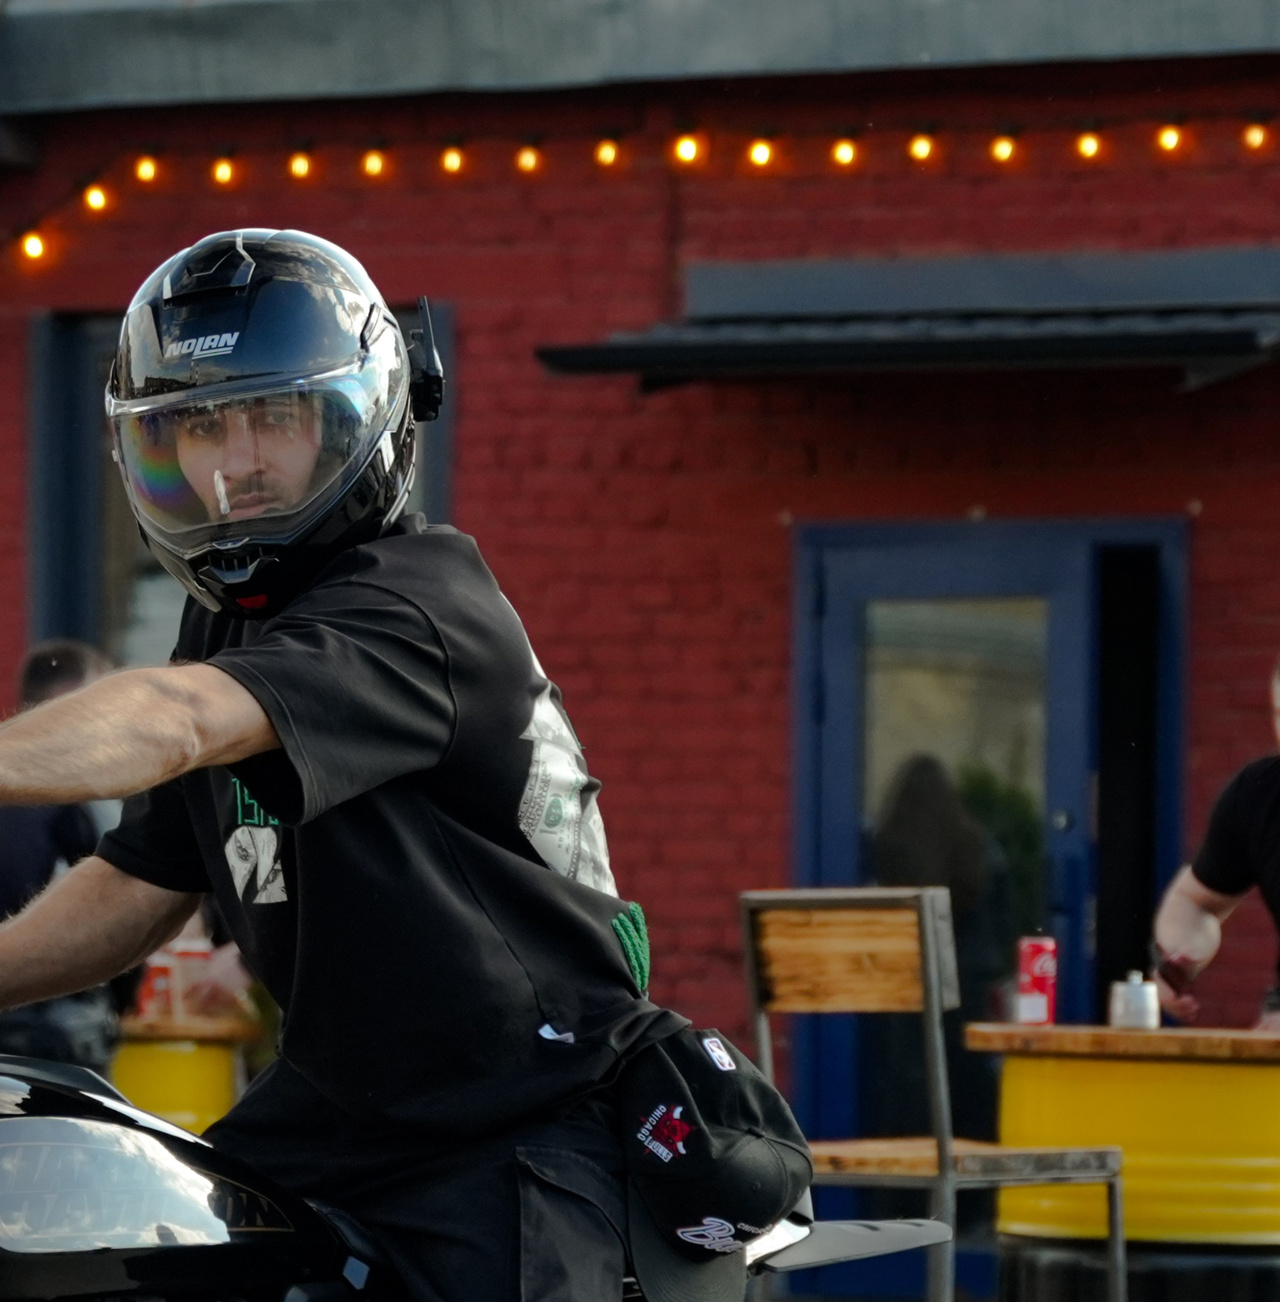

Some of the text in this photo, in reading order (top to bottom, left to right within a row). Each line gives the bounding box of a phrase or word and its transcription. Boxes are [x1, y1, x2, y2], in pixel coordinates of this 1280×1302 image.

[164, 331, 240, 360] NOLAN
[637, 1104, 667, 1141] CHICAGO
[645, 1139, 672, 1161] BULLS
